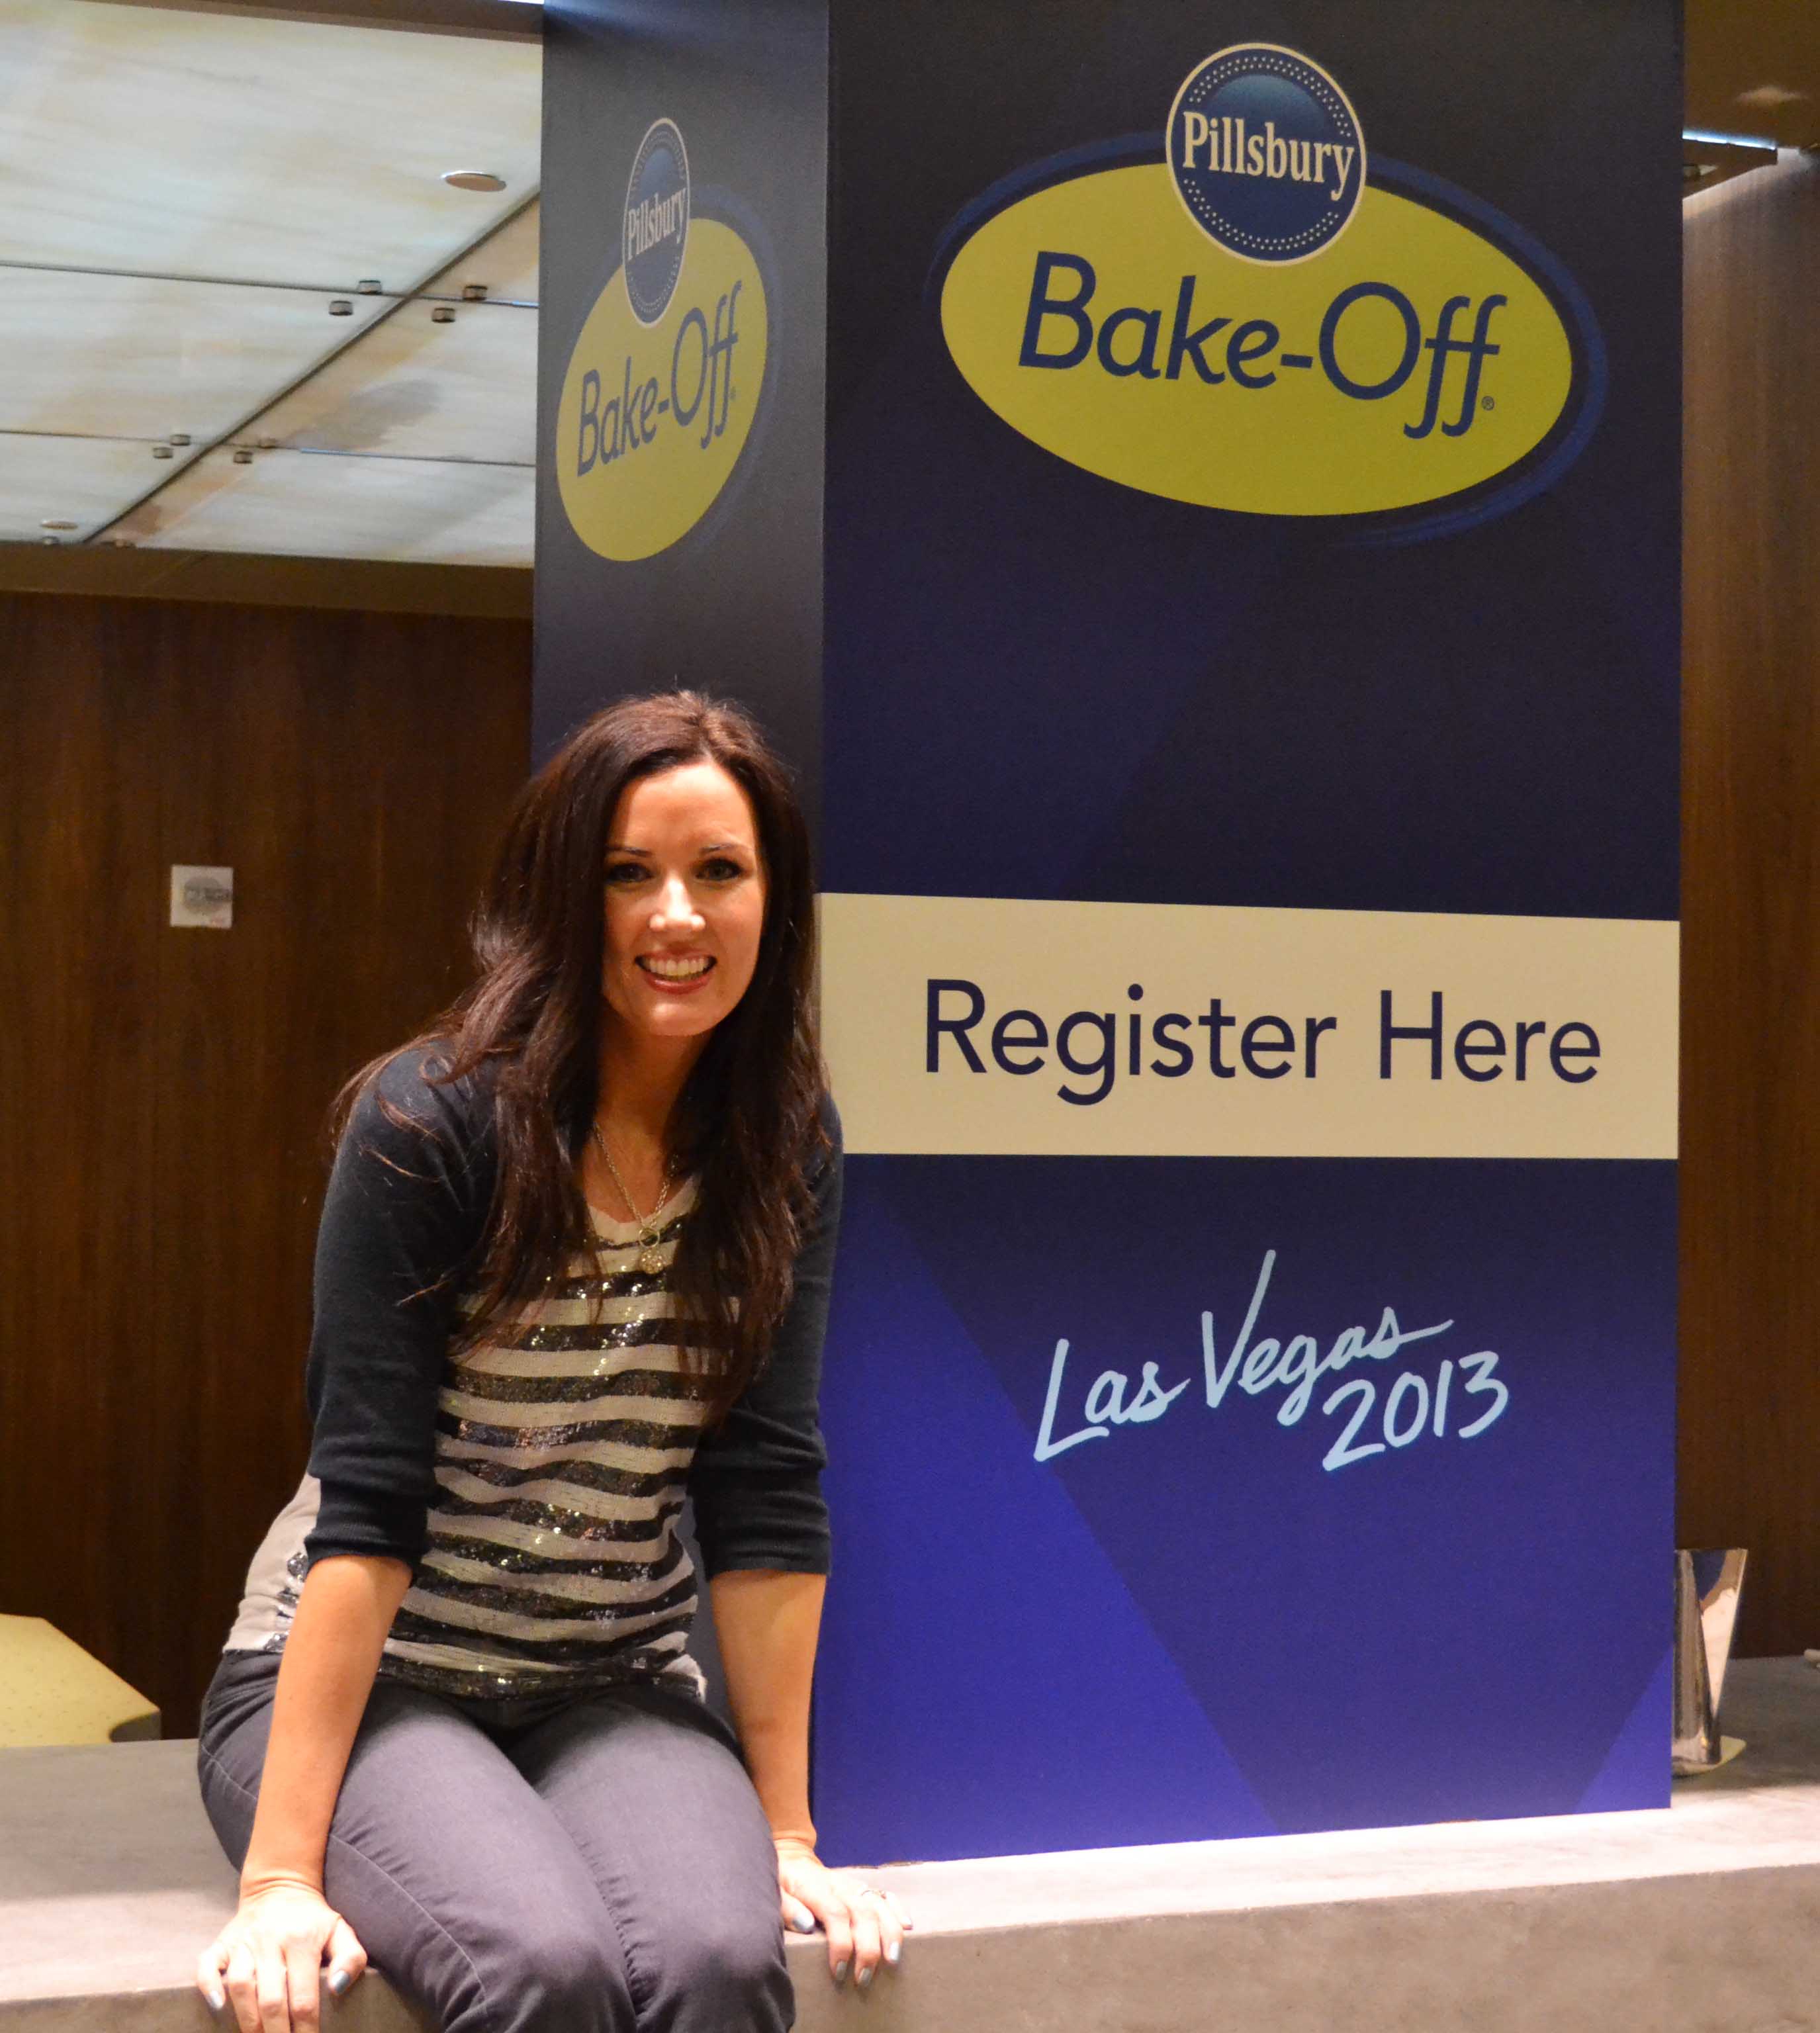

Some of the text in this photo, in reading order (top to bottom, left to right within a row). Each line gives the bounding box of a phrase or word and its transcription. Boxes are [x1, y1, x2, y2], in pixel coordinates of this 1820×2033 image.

[1182, 111, 1355, 201] Pillsbury
[626, 187, 687, 261] Pillsbury
[577, 279, 742, 477] Bake-Off
[926, 978, 1601, 1106] Register Here
[1033, 1249, 1454, 1462] Las Vegas
[1322, 1350, 1509, 1471] 2013
